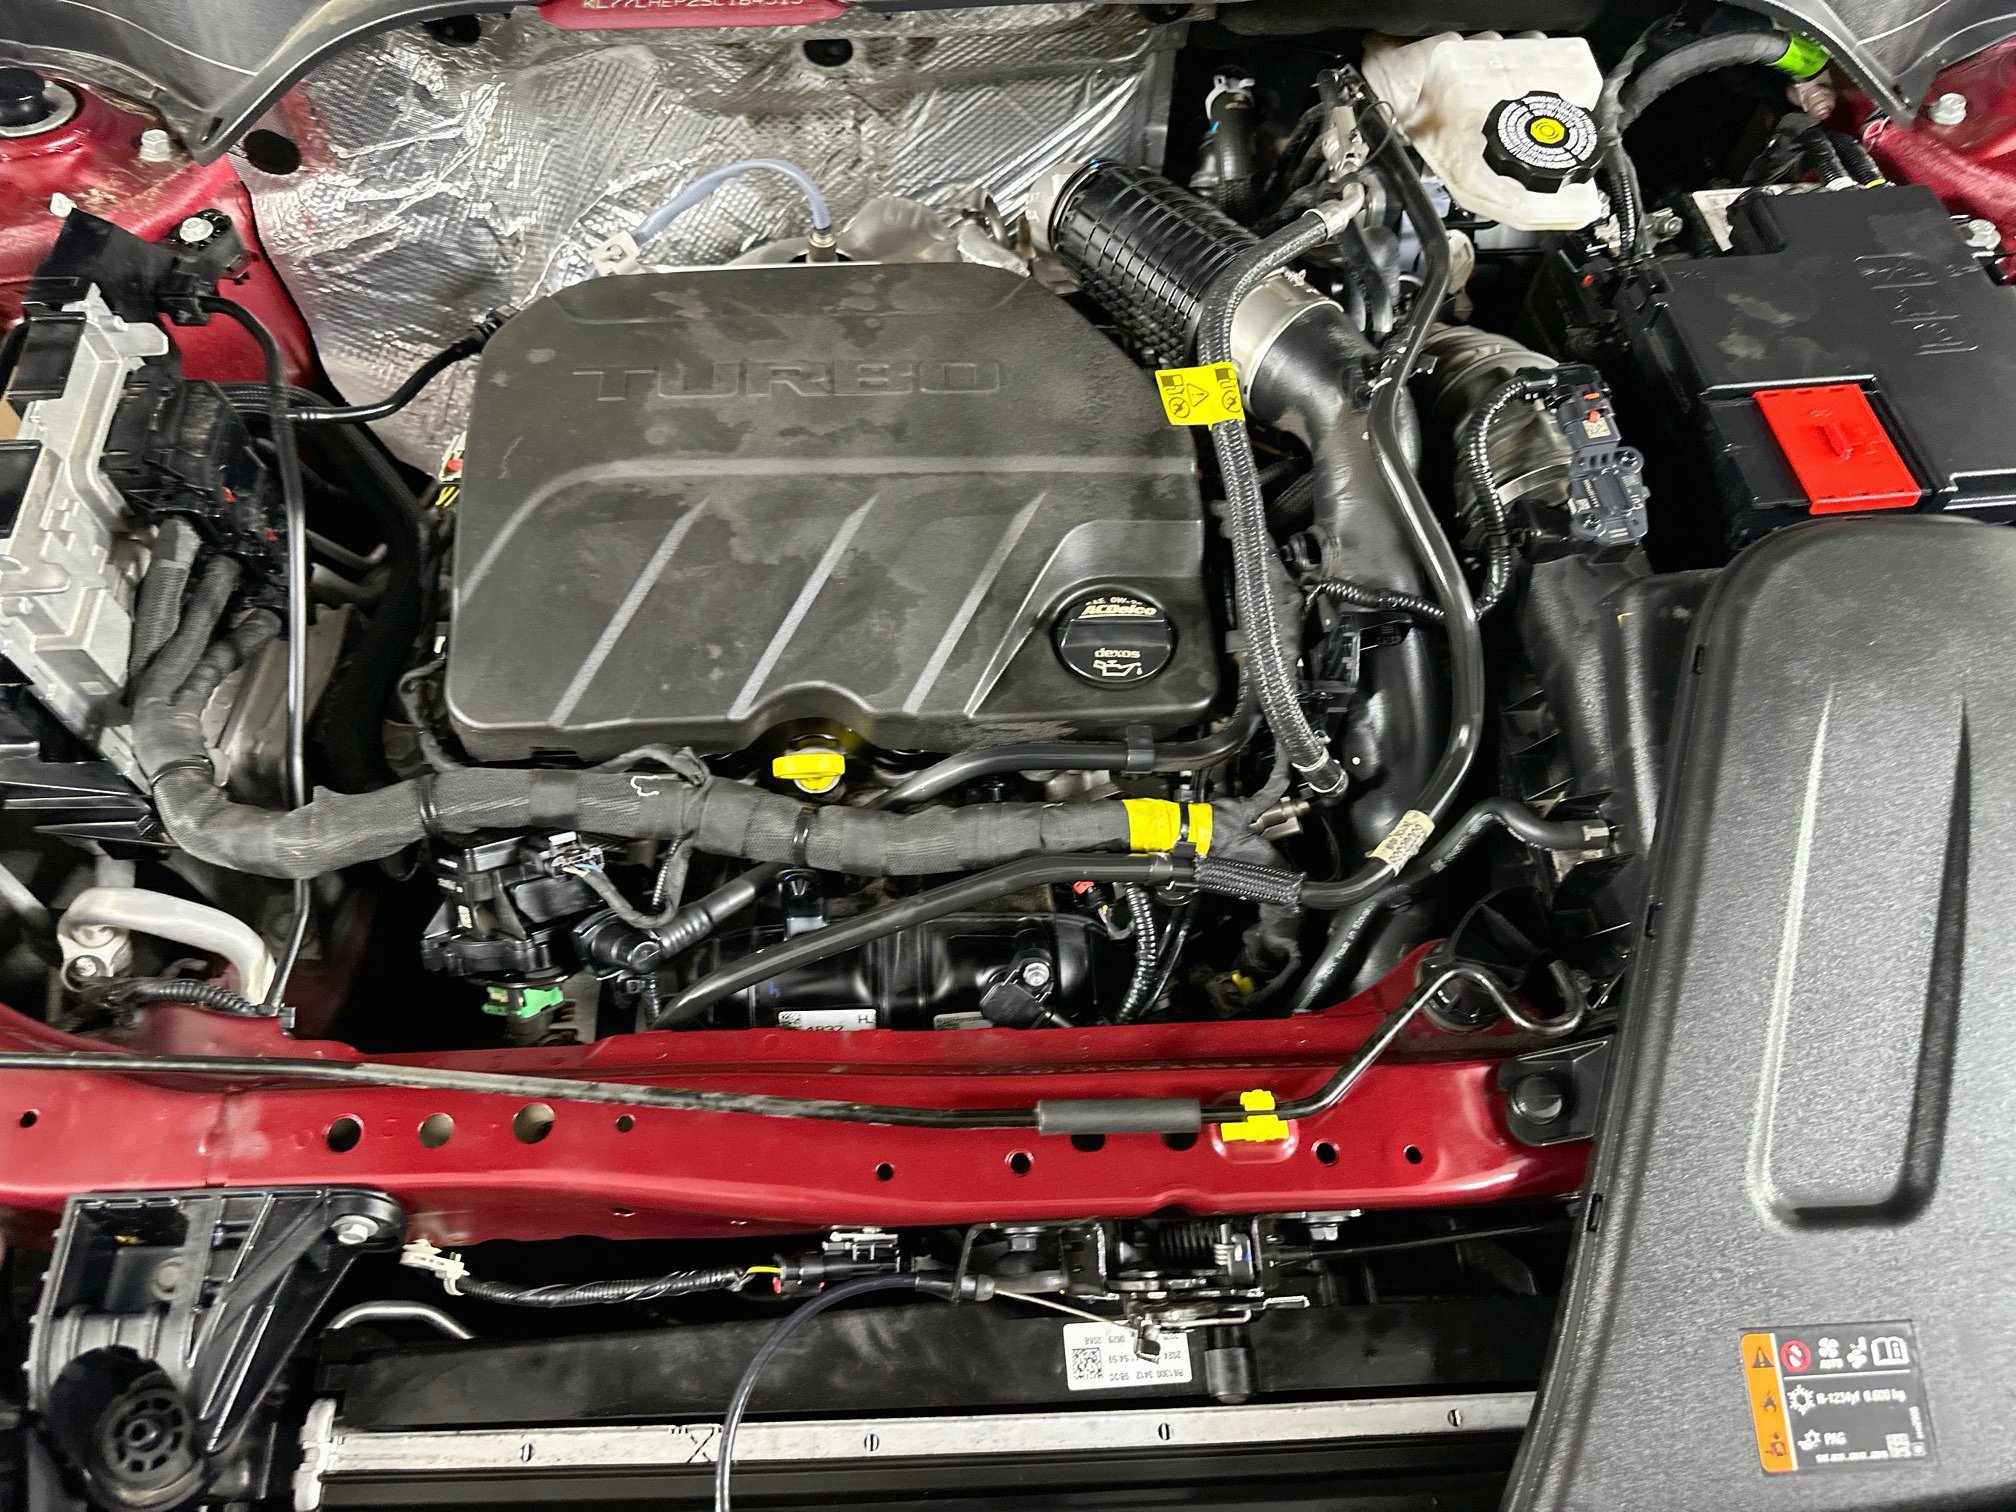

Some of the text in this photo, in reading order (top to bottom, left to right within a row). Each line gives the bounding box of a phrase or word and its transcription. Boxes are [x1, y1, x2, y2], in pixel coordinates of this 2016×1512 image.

[572, 361, 999, 401] TURBO
[1081, 604, 1157, 617] ACDelco
[1094, 647, 1141, 659] dexos
[1823, 1431, 1847, 1446] PAG
